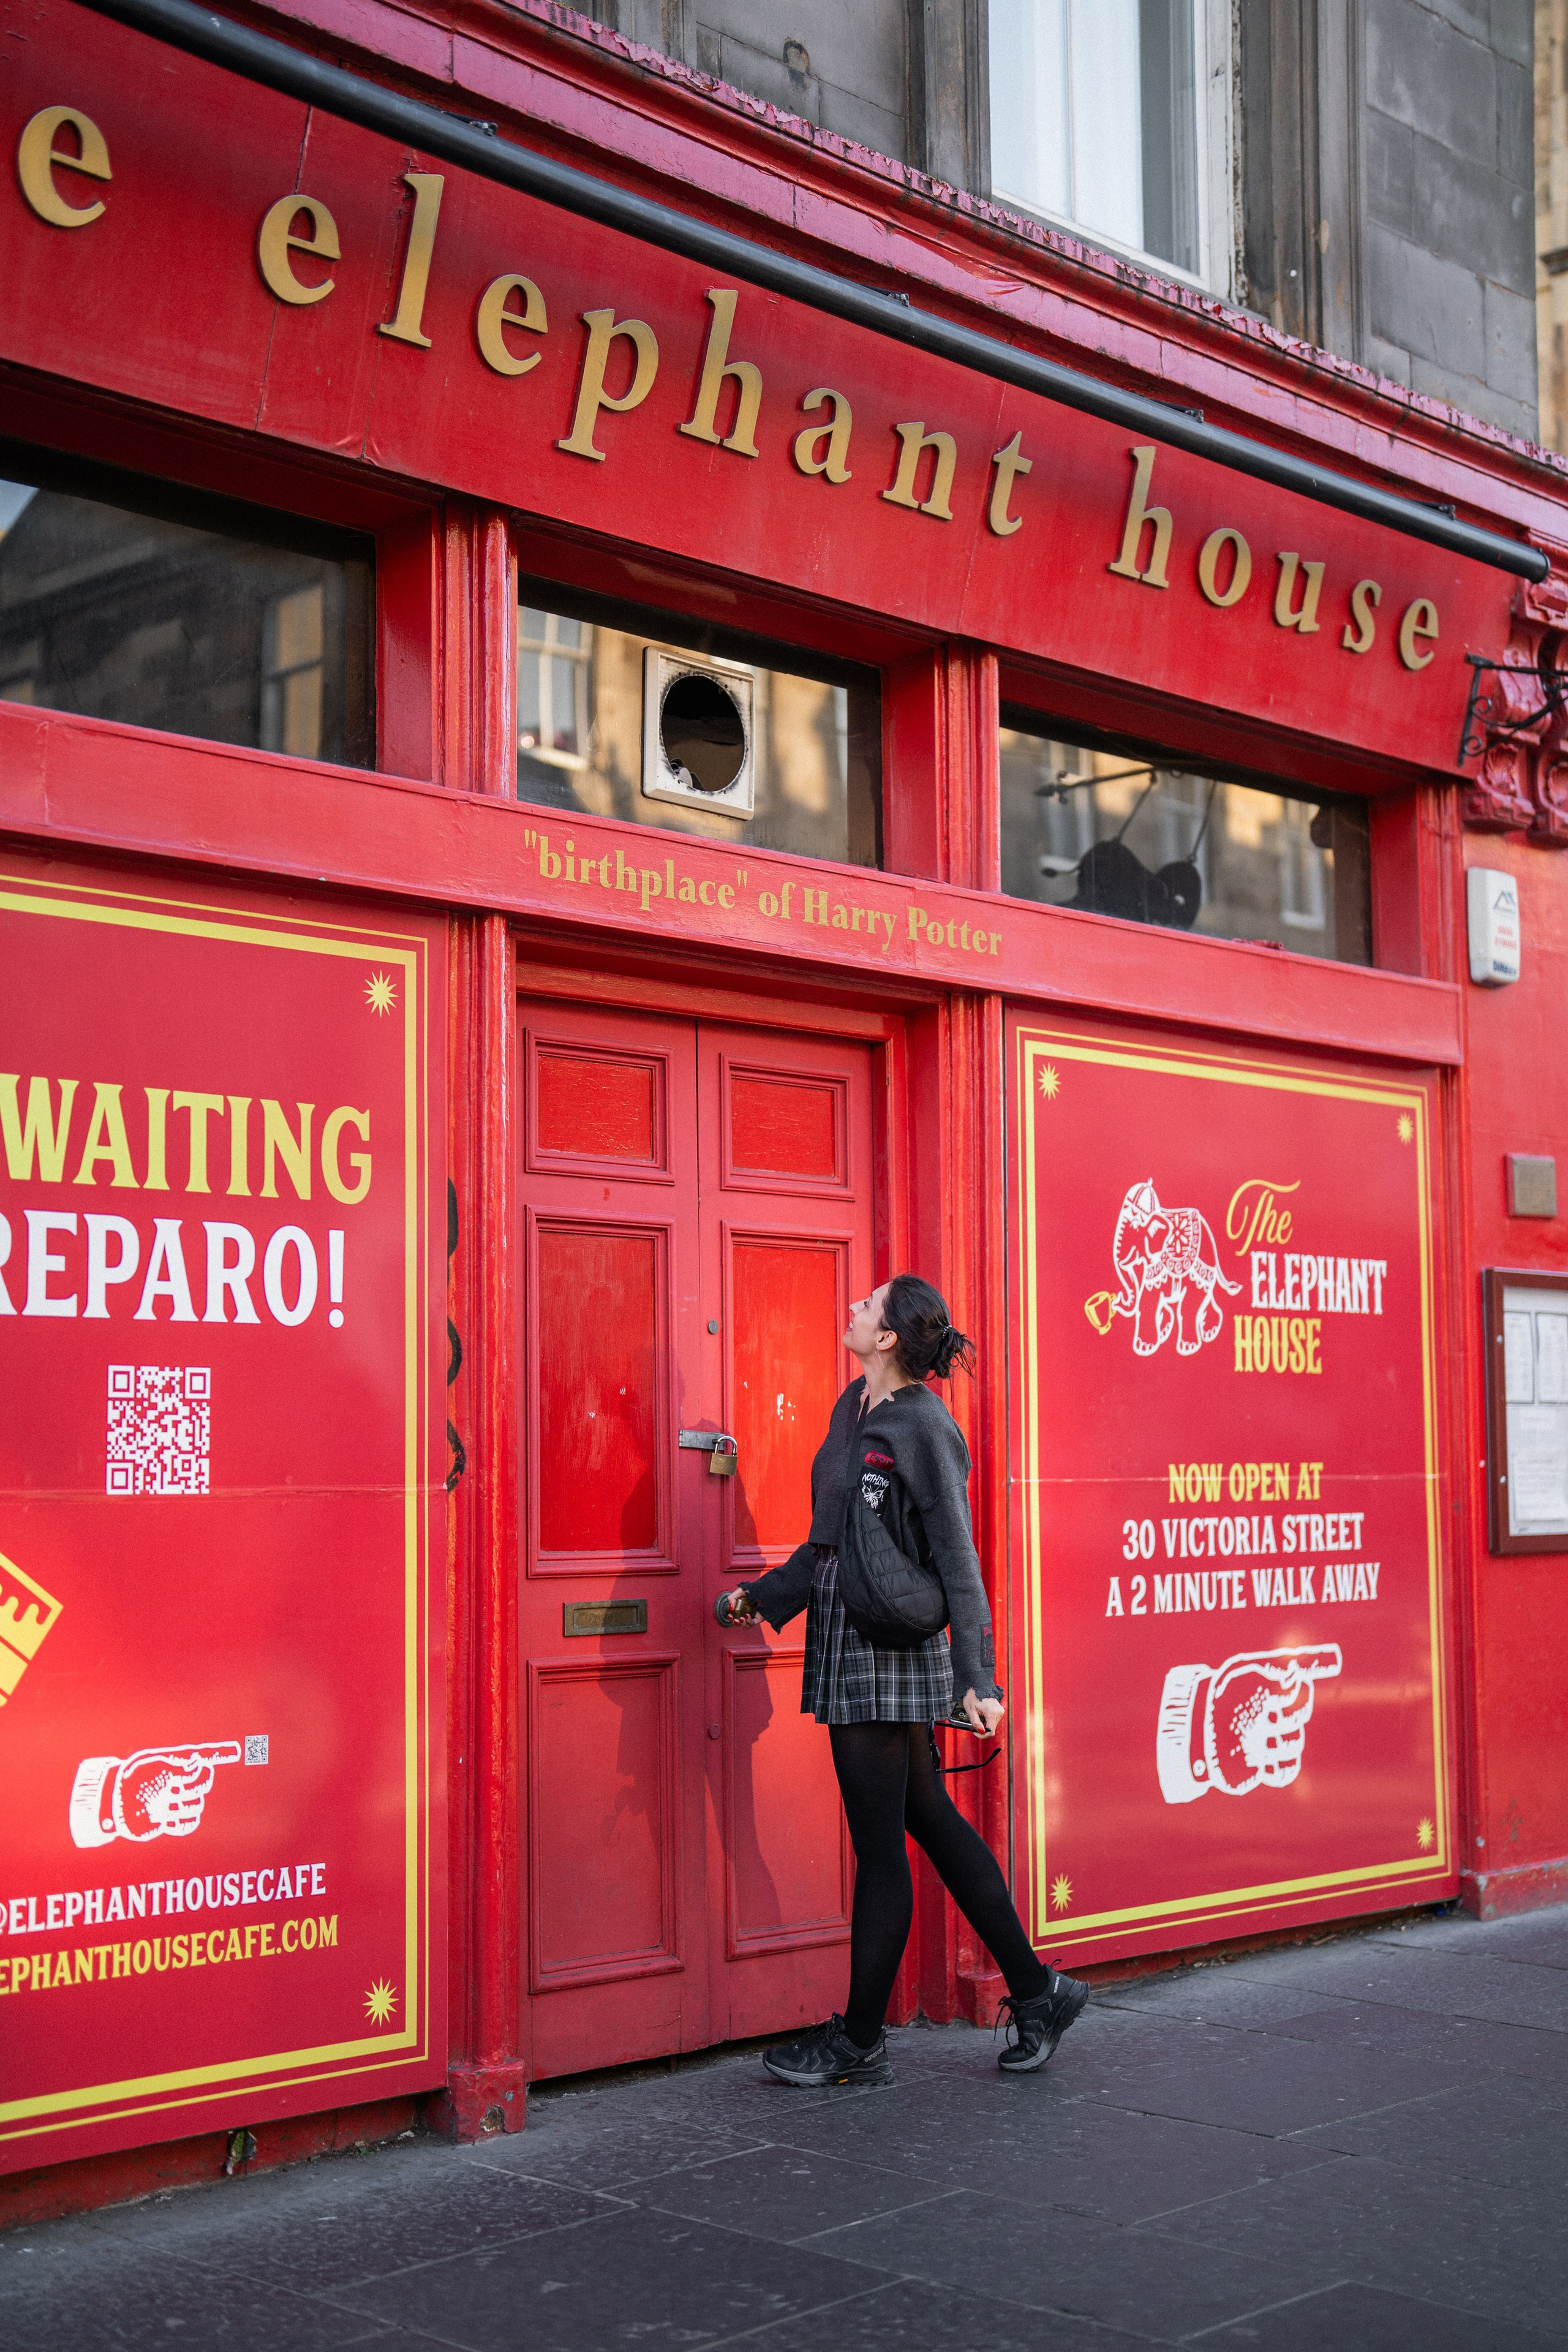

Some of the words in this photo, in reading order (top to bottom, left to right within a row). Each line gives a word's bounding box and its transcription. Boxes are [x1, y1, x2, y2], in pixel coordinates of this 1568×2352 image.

[257, 173, 1033, 536] elephant
[1107, 445, 1439, 671] house
[524, 829, 748, 911] "birthplace"
[758, 881, 796, 920] of
[802, 887, 898, 951] Harry
[907, 905, 1002, 956] Potter
[0, 1072, 372, 1205] WAITING
[1226, 1179, 1301, 1256] The
[0, 1209, 345, 1328] EPARO!
[1251, 1251, 1387, 1315] ELEPHANT
[1233, 1314, 1322, 1374] HOUSE
[861, 1472, 890, 1489] NOTHING
[1168, 1463, 1224, 1504] NOW
[1228, 1463, 1290, 1502] OPEN
[1295, 1462, 1324, 1501] AT
[1122, 1519, 1156, 1561] 30
[1161, 1515, 1278, 1558] VICTORIA
[1281, 1512, 1365, 1553] STREET
[1105, 1576, 1125, 1618] A
[1131, 1575, 1148, 1616] 2
[1153, 1569, 1247, 1615] MINUTE
[1251, 1566, 1316, 1608] WALK
[1321, 1562, 1381, 1603] AWAY
